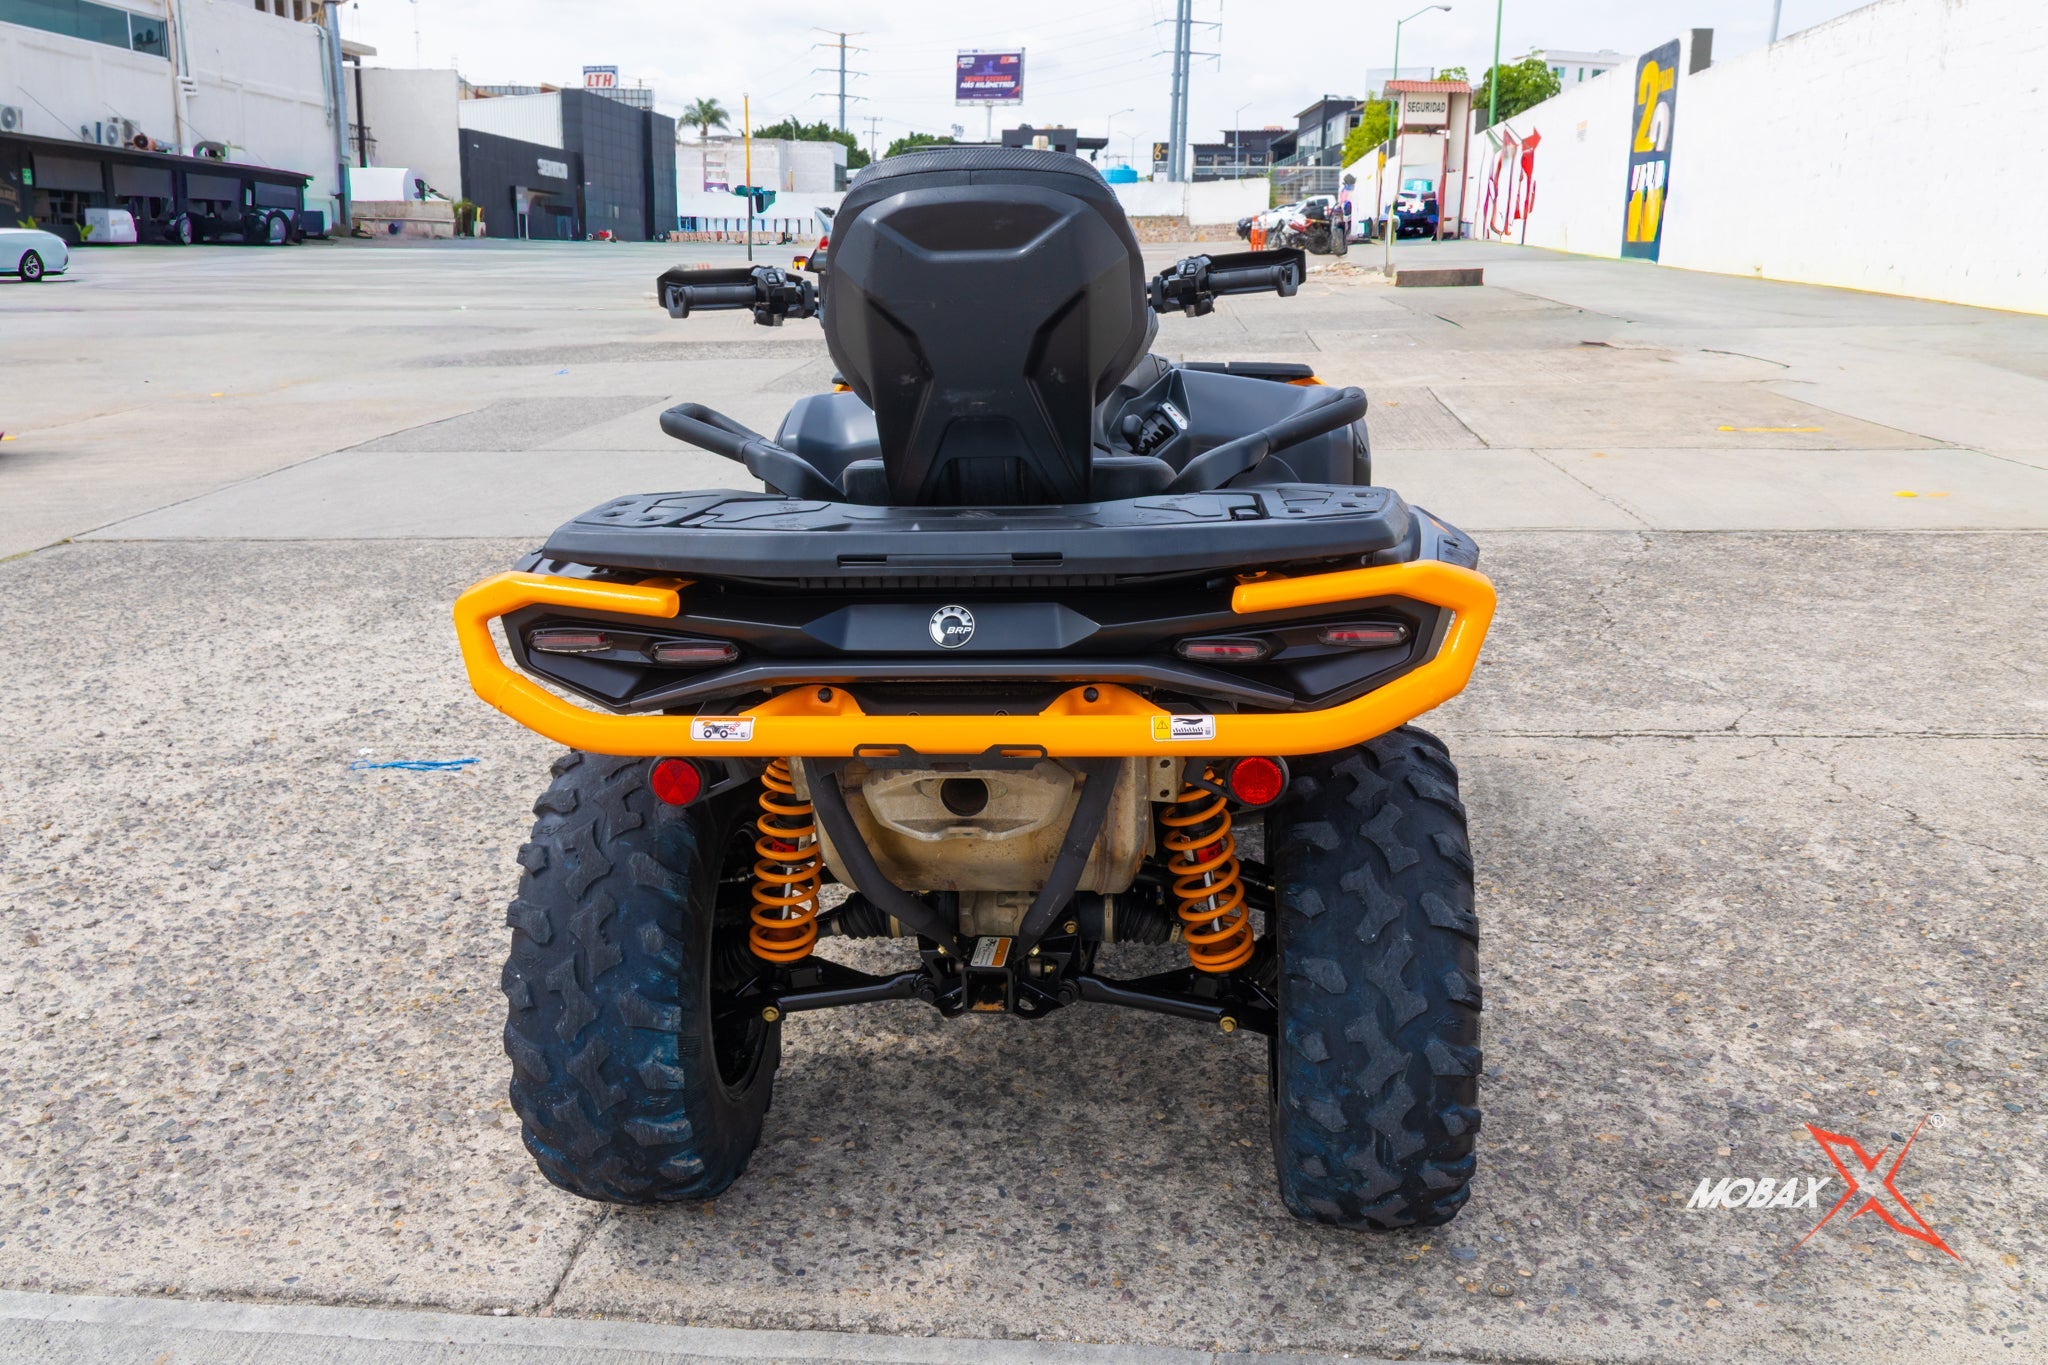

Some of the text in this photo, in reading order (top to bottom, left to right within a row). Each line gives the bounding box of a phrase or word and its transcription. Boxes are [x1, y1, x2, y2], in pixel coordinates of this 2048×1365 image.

[587, 74, 612, 87] LTH
[1407, 101, 1446, 112] SEGURIDAD
[946, 626, 972, 635] BRP
